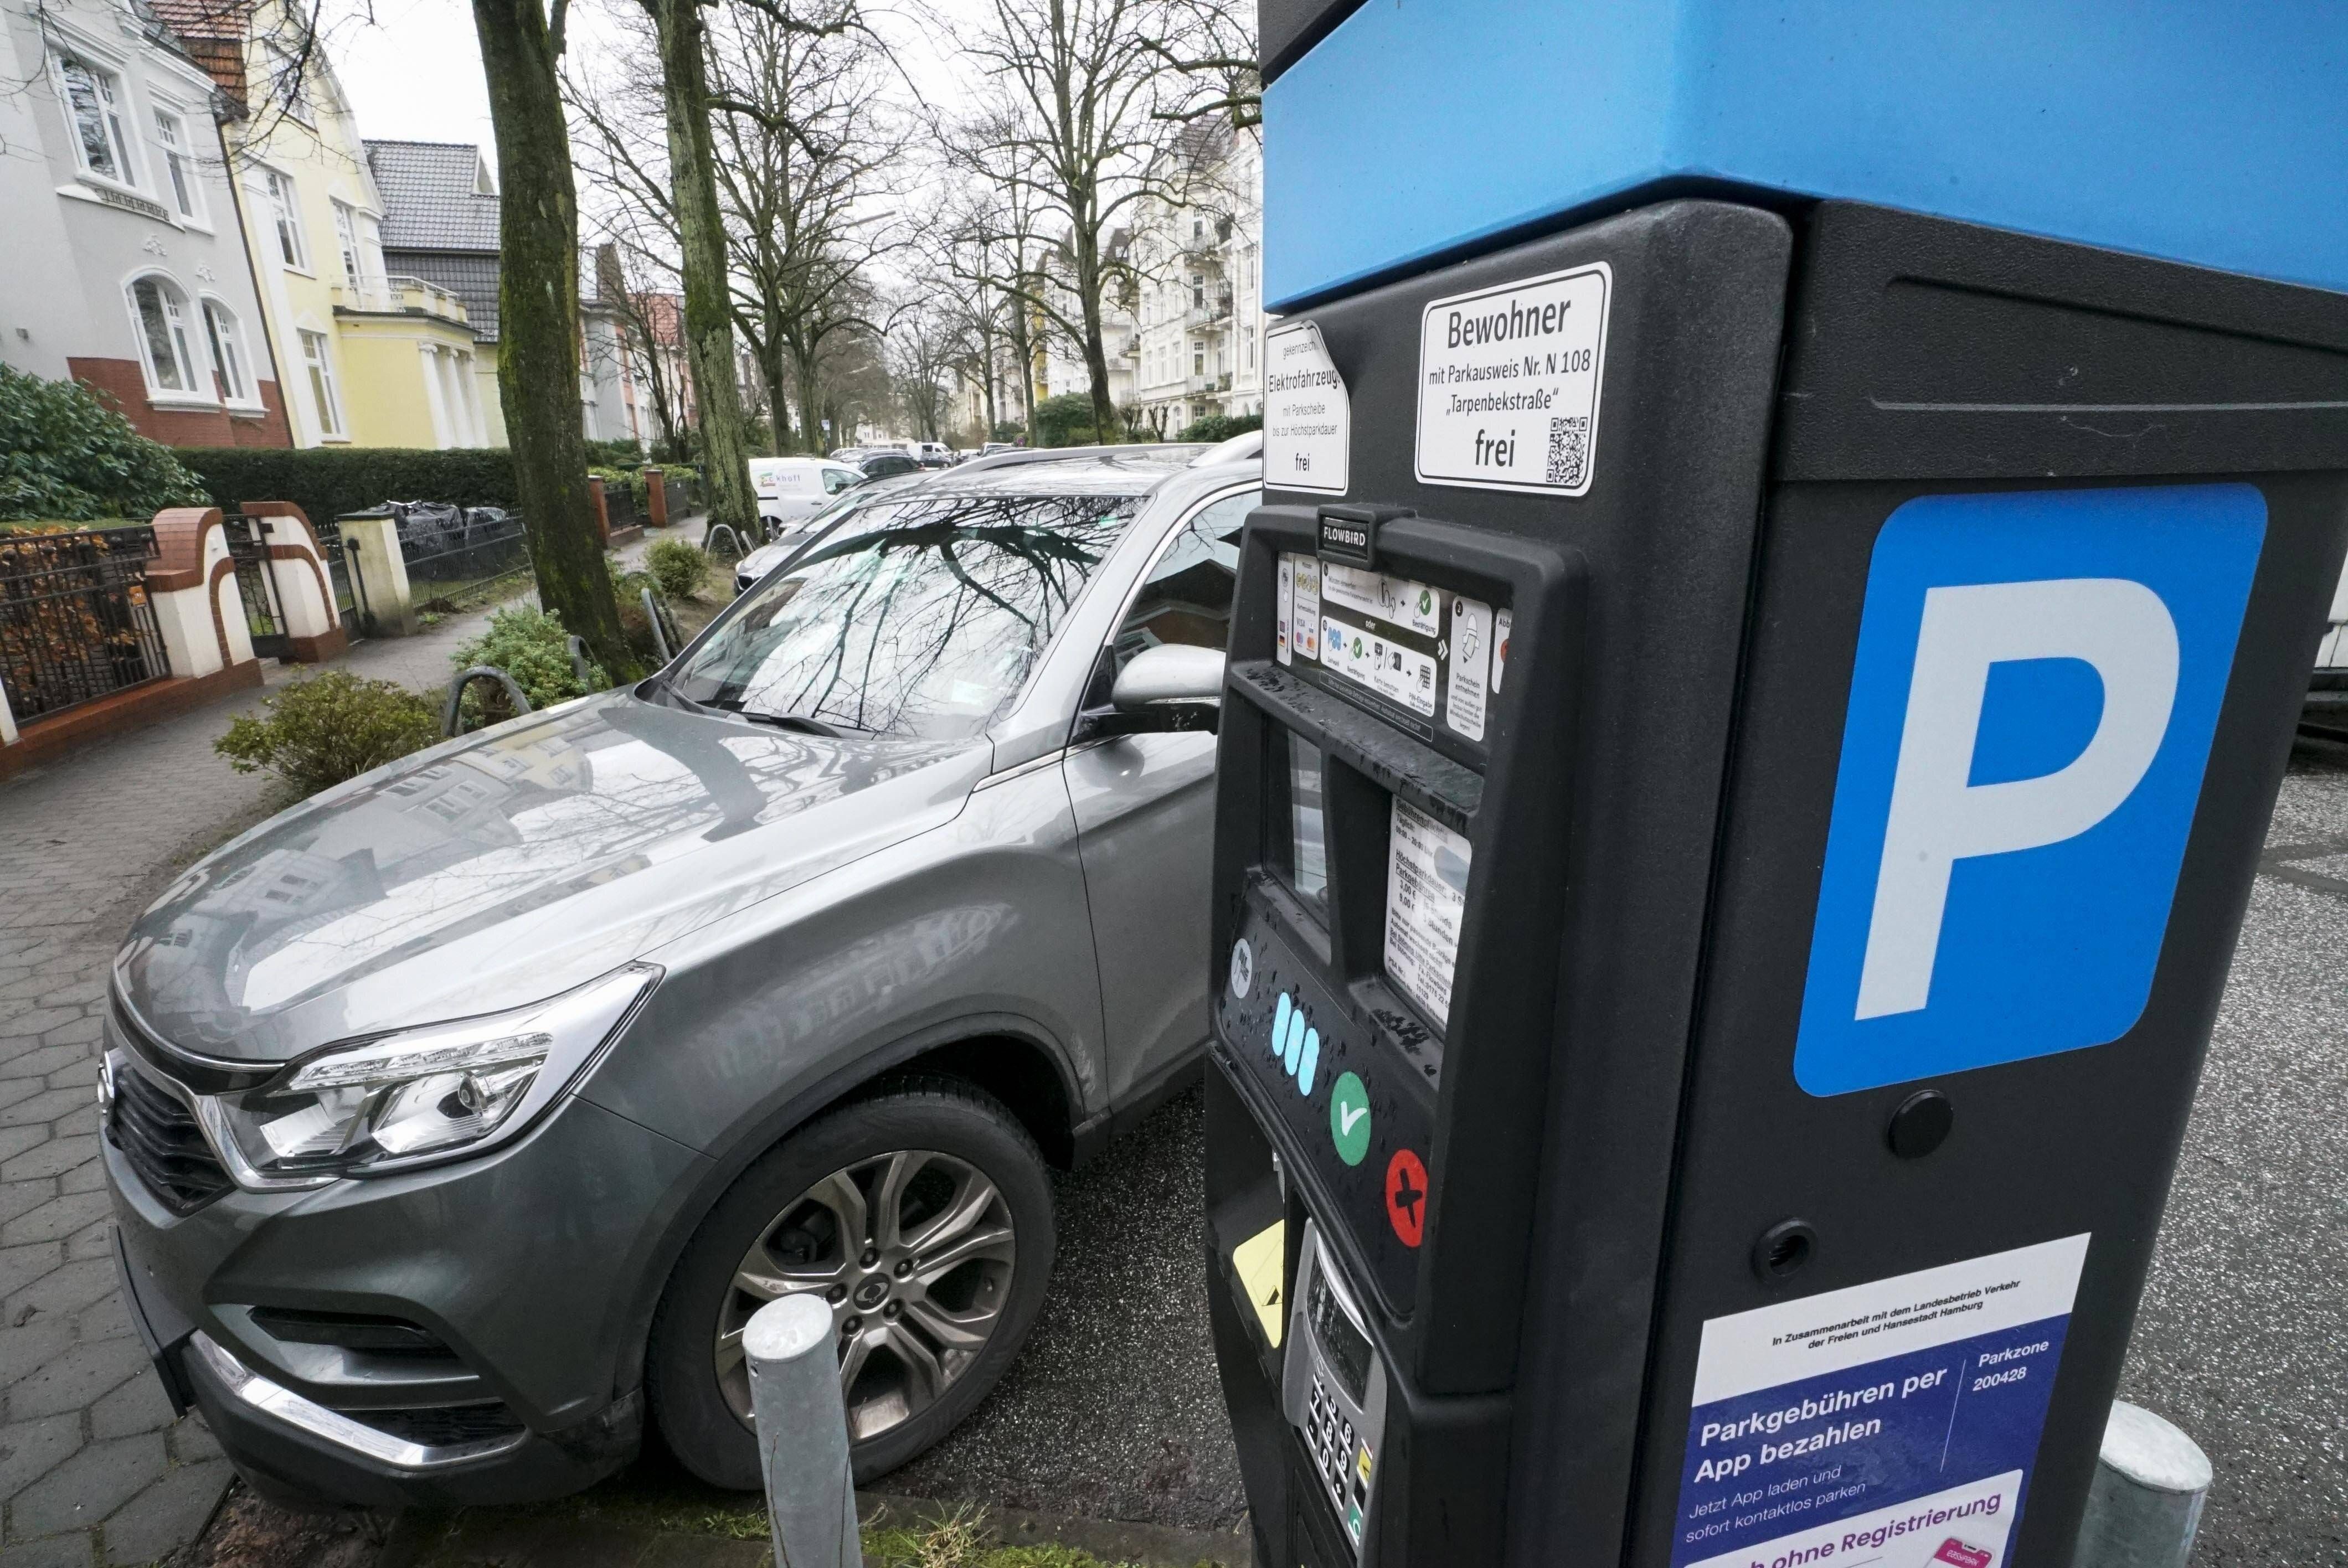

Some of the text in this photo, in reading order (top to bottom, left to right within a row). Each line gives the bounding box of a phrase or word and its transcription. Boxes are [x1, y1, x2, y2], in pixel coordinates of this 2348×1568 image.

[1448, 300, 1571, 348] Bewohner
[1429, 349, 1591, 385] mit Parkausweis Nr. N 108
[1283, 402, 1325, 416] mit Parkscheibe
[1291, 422, 1337, 439] Höchstparkdauer
[1475, 429, 1516, 467] frei
[1295, 452, 1310, 472] frei
[1324, 526, 1366, 546] FLOWBIRD
[1499, 617, 1511, 628] Abb
[1455, 684, 1480, 699] entnehmen
[1456, 673, 1480, 689] Parkschein
[1855, 578, 2180, 1020] P
[1397, 813, 1415, 832] Täglich:
[1396, 863, 1435, 901] Parkgebühren
[1773, 1280, 2021, 1347] In Zusammenarbeit mit dem Landesbetrieb Verkehr
[1808, 1301, 1984, 1349] der Freien und Hansestadt Hamburg
[1978, 1340, 2050, 1368] Parkzone
[1972, 1366, 2027, 1391] 200428
[1700, 1368, 1948, 1447] Parkgebühren per
[1326, 1421, 1333, 1442] 8
[1340, 1450, 1347, 1472] 9
[1345, 1423, 1352, 1444] 6
[1693, 1418, 1882, 1483] App bezahlen
[1322, 1448, 1329, 1468] 0
[1689, 1465, 1842, 1519] Jetzt App laden und
[1685, 1482, 1866, 1543] sofort kontaktlos parken
[1771, 1493, 2002, 1568] ohne Registrierung
